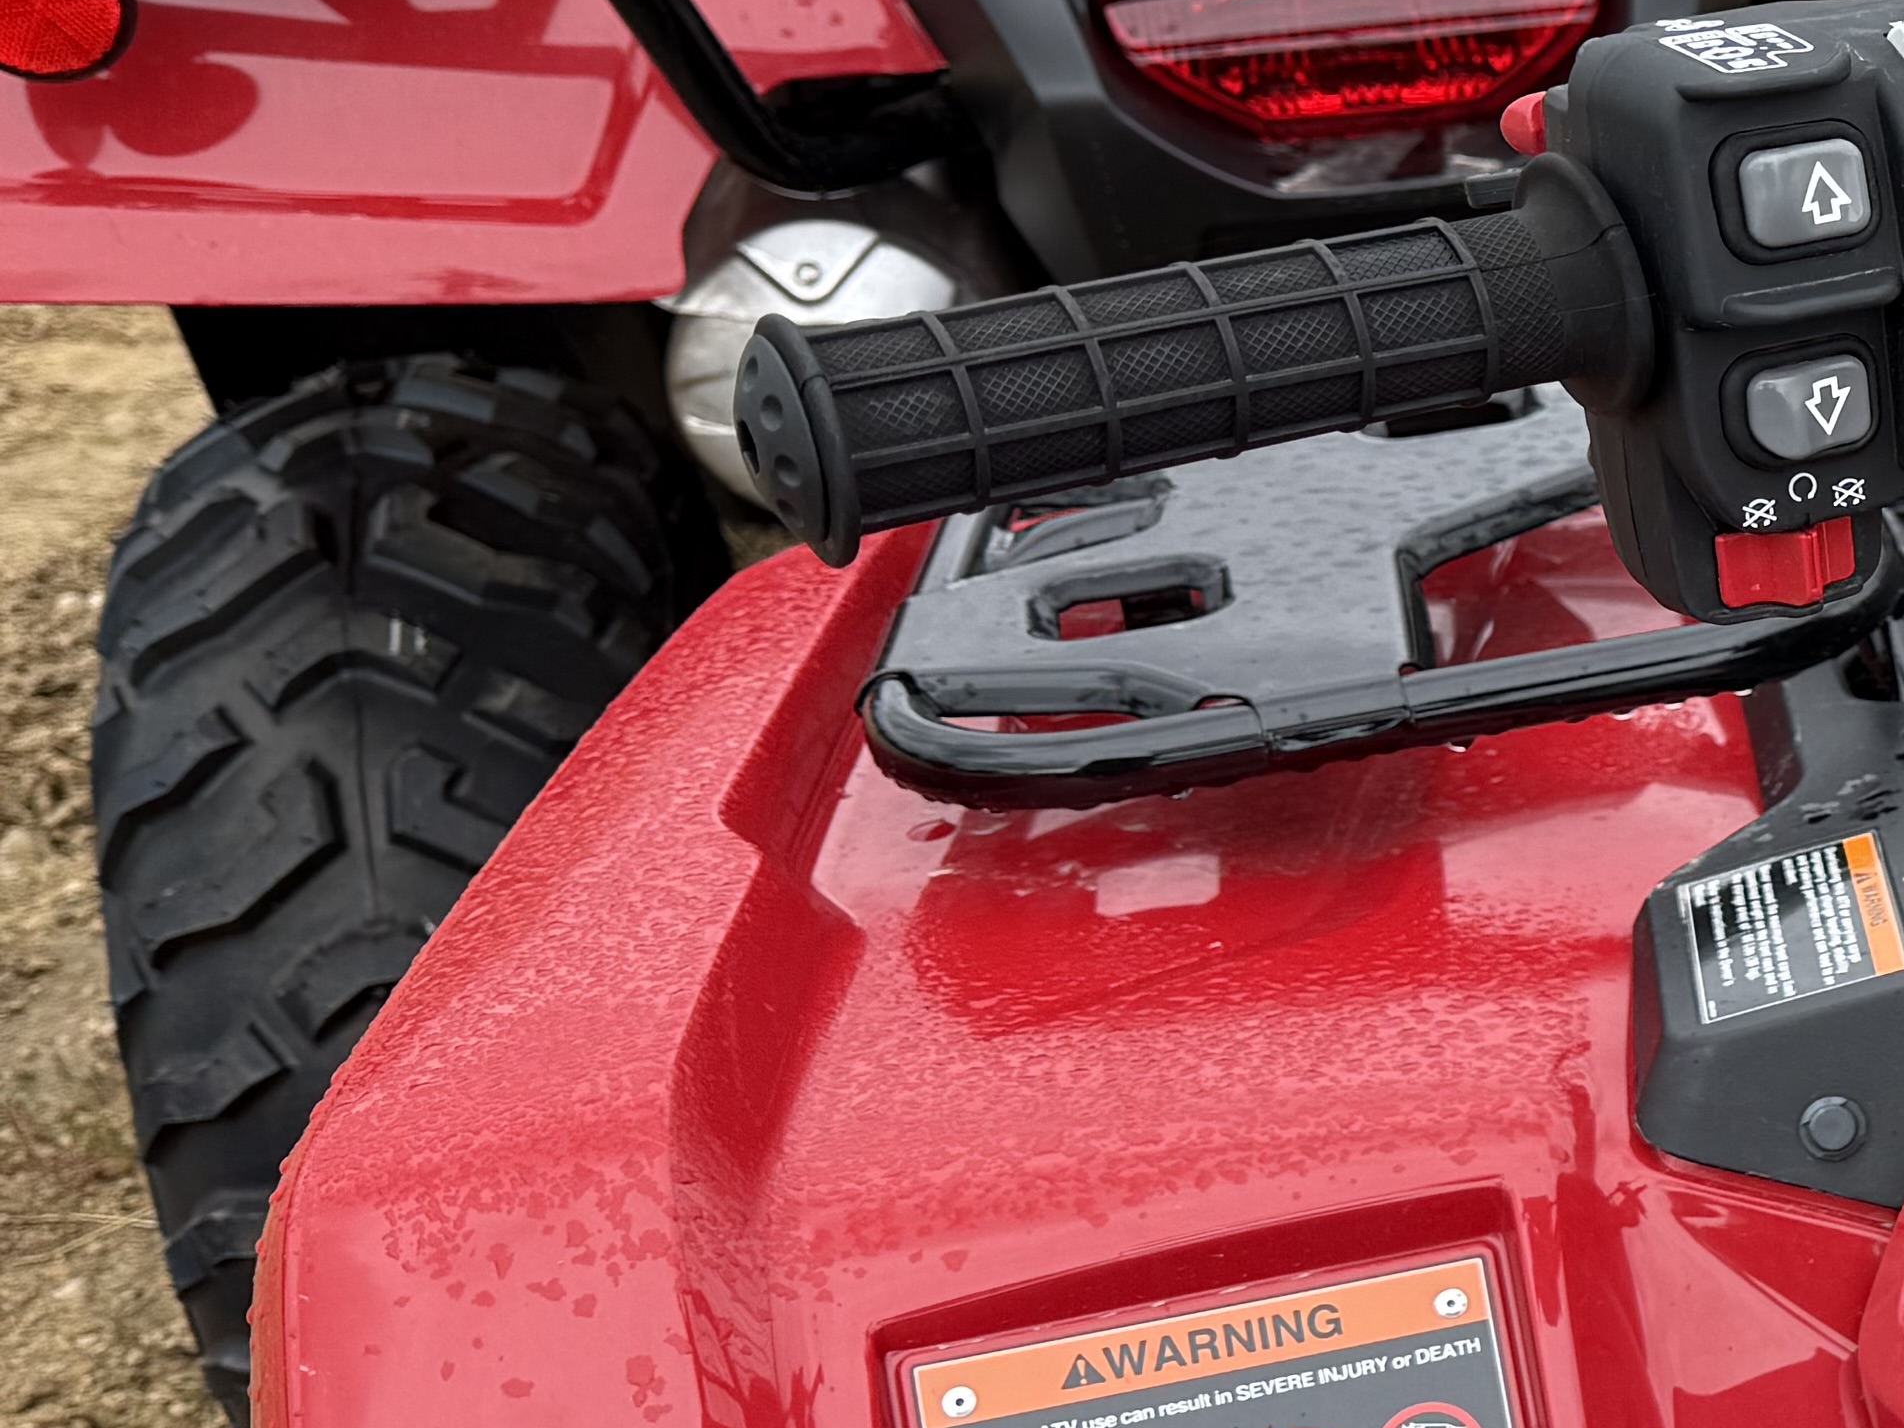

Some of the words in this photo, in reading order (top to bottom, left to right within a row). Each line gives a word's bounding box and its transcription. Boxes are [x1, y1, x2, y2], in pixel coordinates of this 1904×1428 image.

[1102, 1304, 1343, 1380] WARNING
[1119, 1407, 1156, 1425] can
[1157, 1393, 1212, 1417] result
[1214, 1390, 1233, 1406] in
[1235, 1371, 1316, 1402] SEVERE
[1317, 1355, 1388, 1385] INJURY
[1390, 1354, 1413, 1370] or
[1414, 1337, 1482, 1365] DEATH
